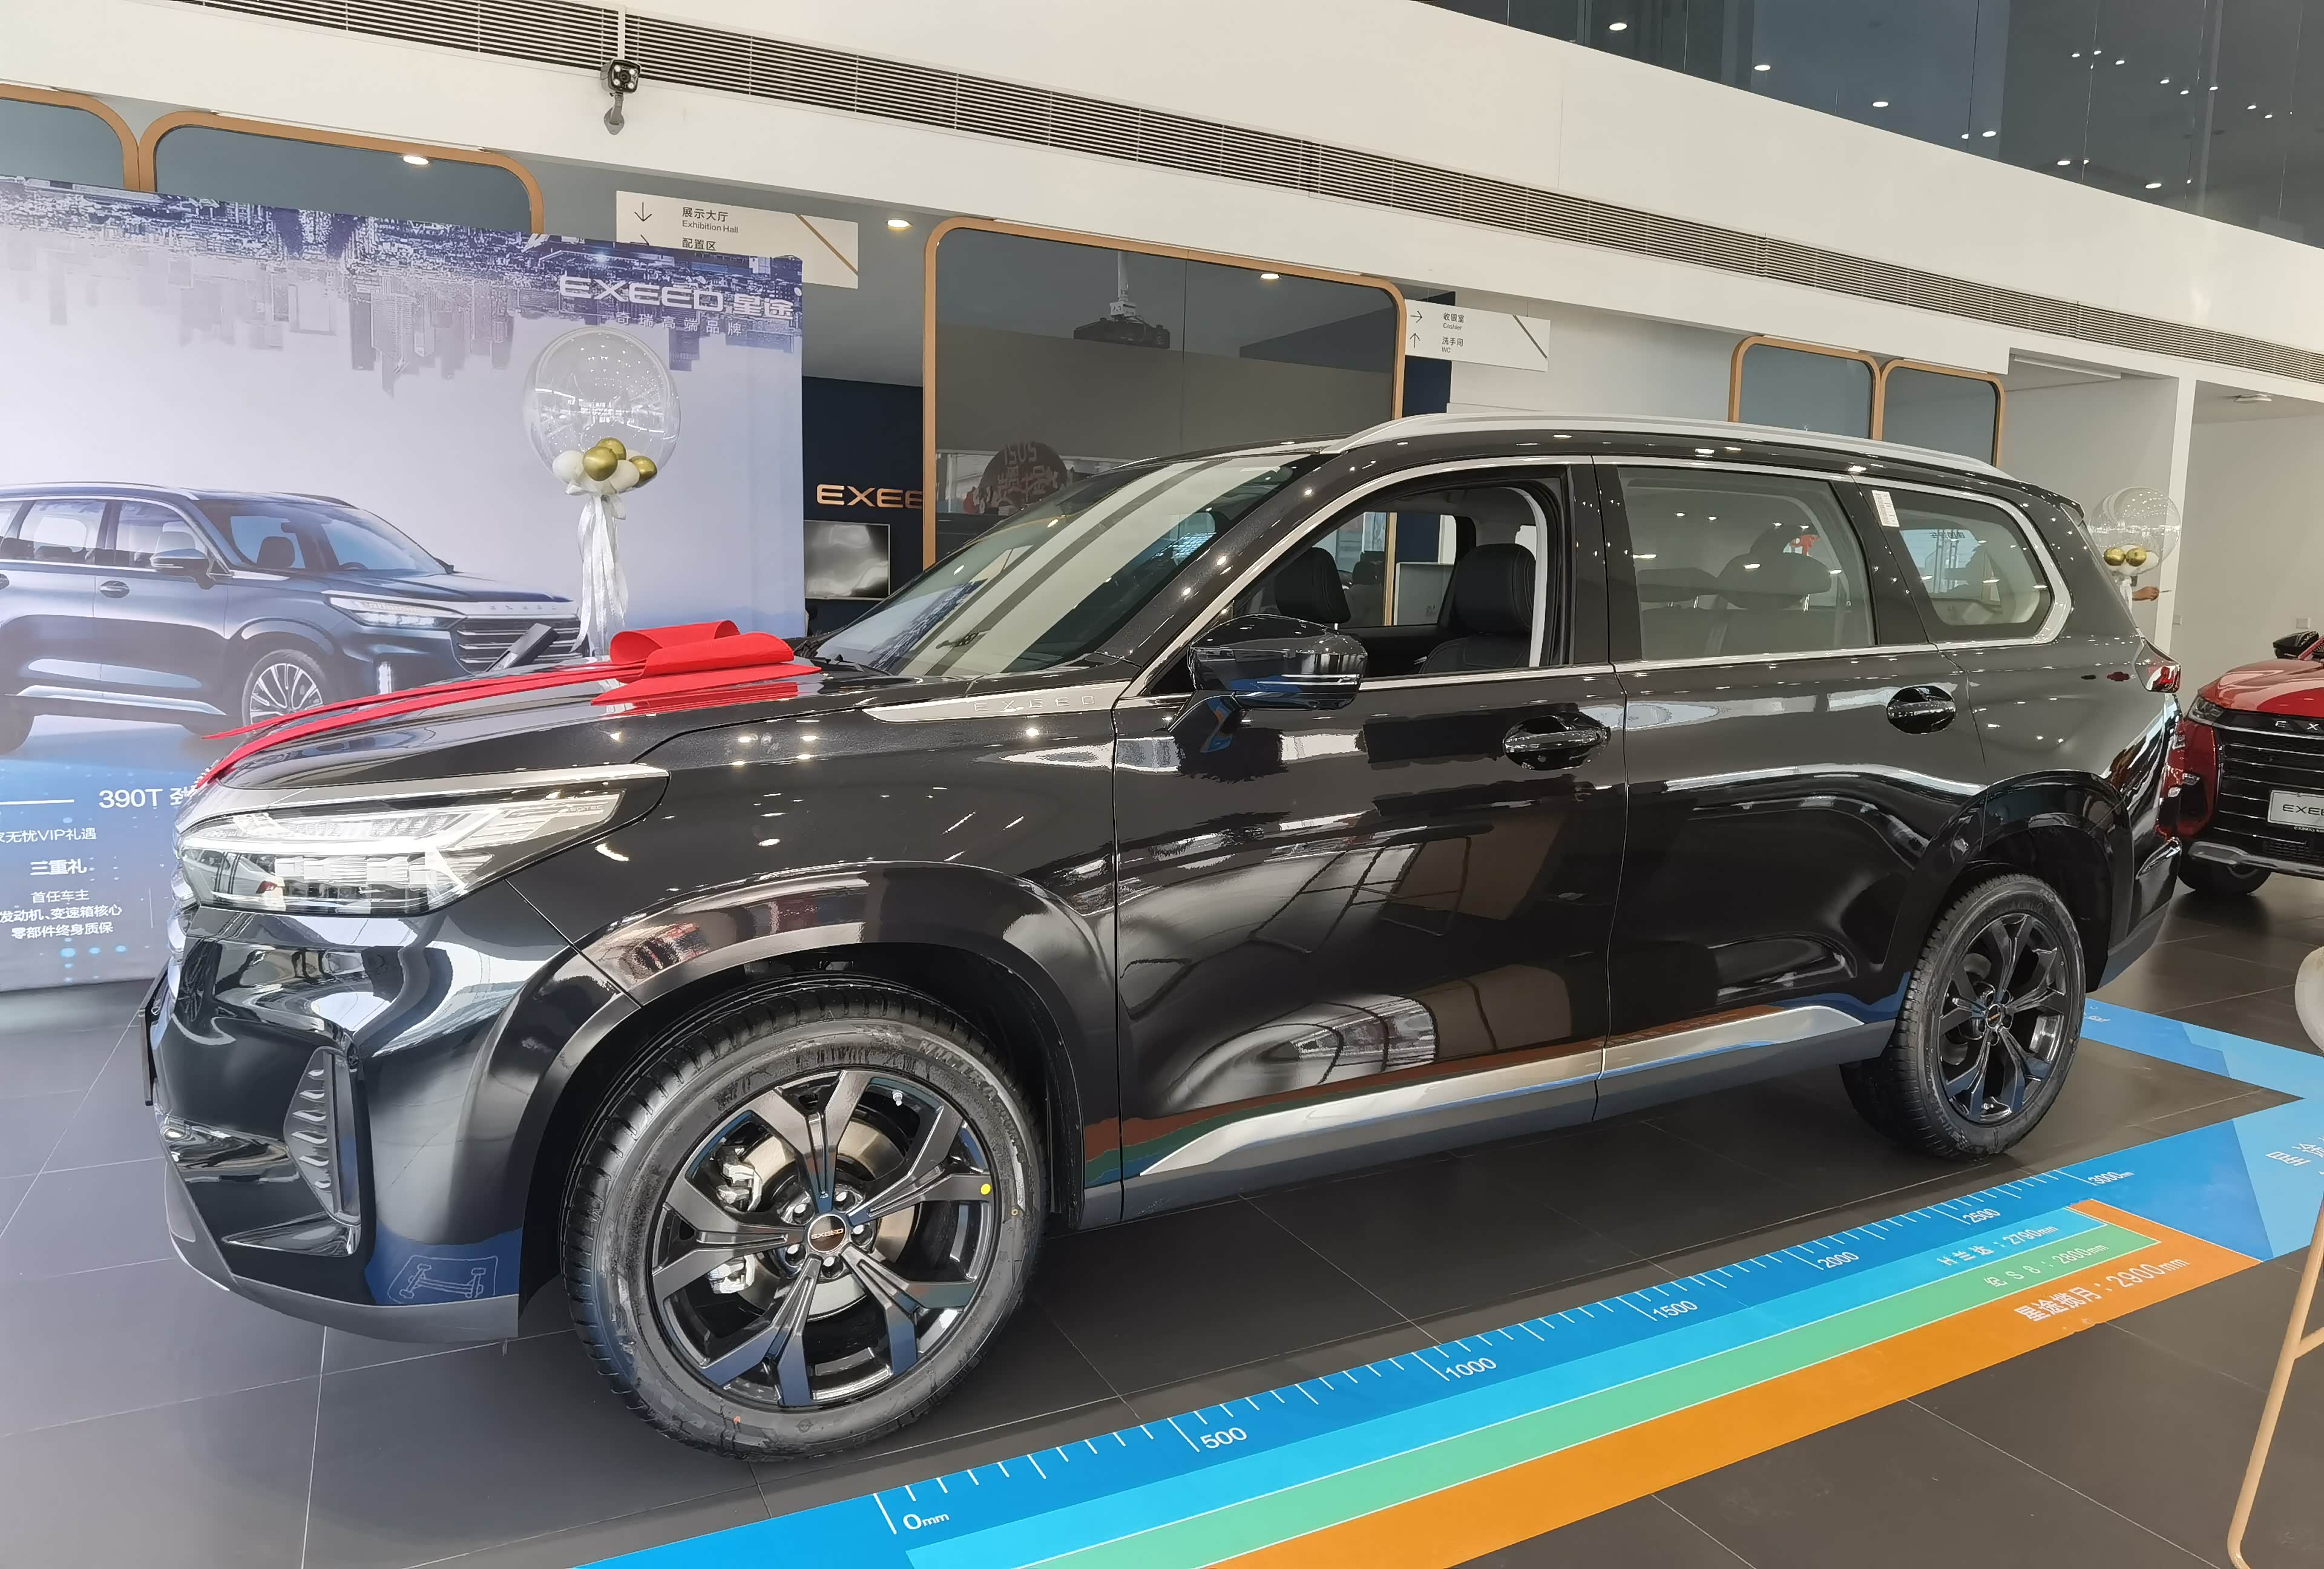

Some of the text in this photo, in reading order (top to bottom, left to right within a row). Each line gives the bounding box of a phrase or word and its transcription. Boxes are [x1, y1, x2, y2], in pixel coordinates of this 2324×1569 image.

[682, 206, 729, 222] 展示大厅
[682, 220, 738, 234] Exhibition Hall
[682, 237, 717, 251] 配置区
[734, 293, 794, 319] 星途
[616, 312, 743, 336] 奇瑞高端品牌
[1442, 336, 1463, 346] 洗手间
[98, 788, 163, 809] 390T
[30, 859, 88, 876] 三重礼
[31, 889, 90, 904] 首任车主
[0, 904, 122, 923] 发动机、变速箱核心
[11, 921, 114, 939] 零部件终身质保
[1817, 1252, 1860, 1269] 2000
[1652, 1300, 1698, 1318] 1500
[1445, 1357, 1497, 1378] 1000
[1200, 1427, 1247, 1449] 500
